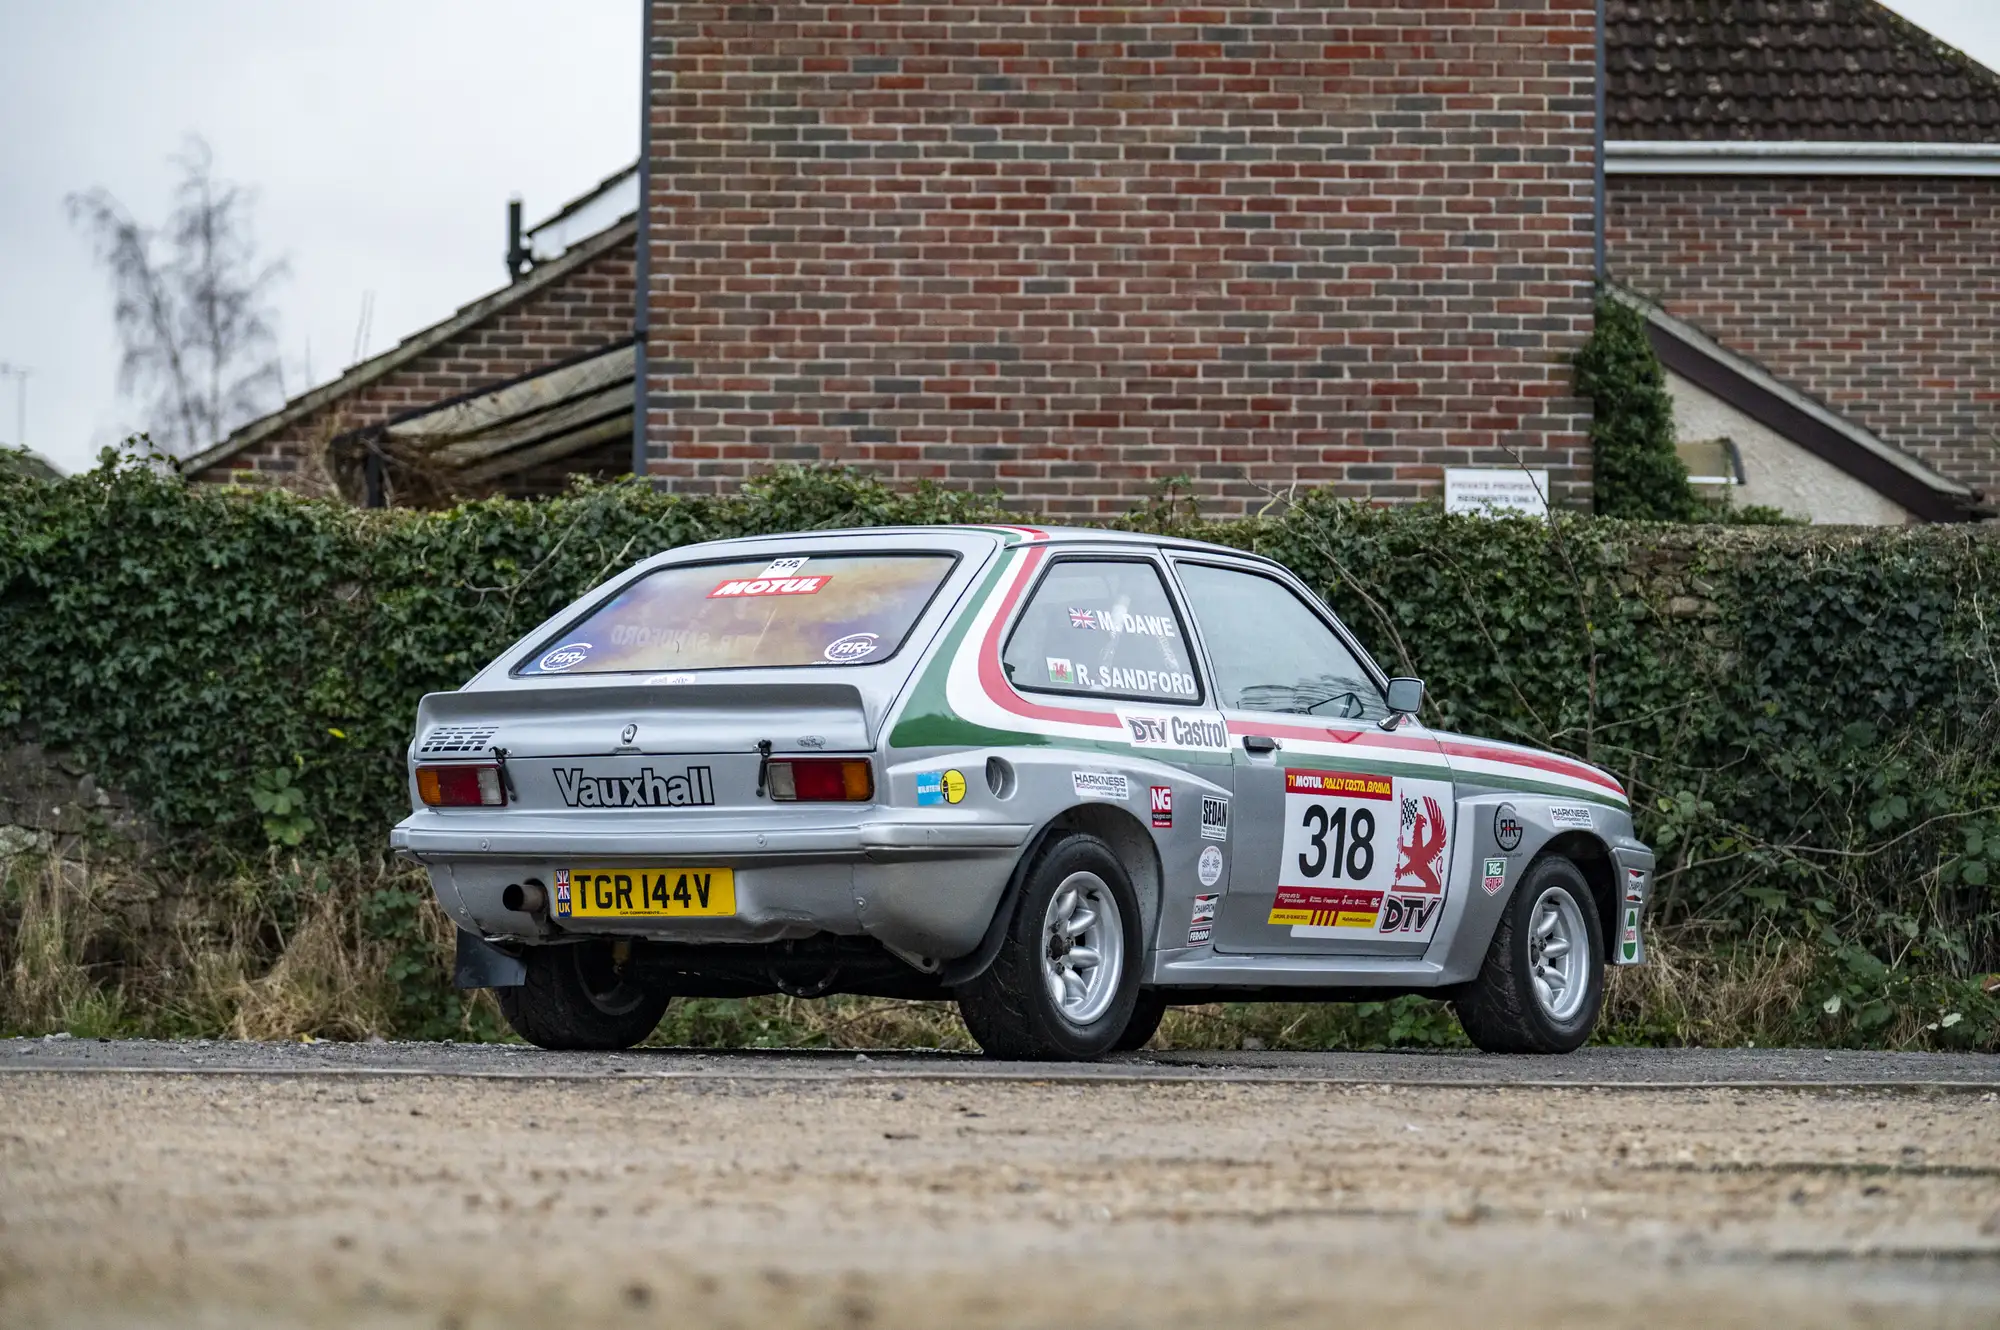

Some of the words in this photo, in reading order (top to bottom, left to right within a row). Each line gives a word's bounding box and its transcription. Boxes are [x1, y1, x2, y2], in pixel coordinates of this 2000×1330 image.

[1450, 481, 1490, 490] PRIVATE
[1513, 494, 1537, 503] ONLY
[712, 578, 821, 596] MOTUL
[1121, 613, 1176, 637] DAWE
[1075, 663, 1096, 686] R.
[1098, 665, 1196, 695] SANDFORD
[1126, 716, 1167, 743] DTV
[1171, 715, 1228, 748] Castrol
[552, 765, 715, 808] Vauxhall
[1074, 773, 1126, 787] HARKNESS
[1296, 775, 1322, 789] MOTUL
[1322, 777, 1344, 791] RALLY
[1344, 779, 1366, 792] COSTA
[1366, 780, 1391, 795] BRAVA
[1151, 788, 1171, 810] NG
[1203, 799, 1228, 828] SEDAN
[1551, 807, 1590, 819] HARKNESS
[1298, 804, 1375, 881] 318
[1488, 862, 1502, 876] TAG
[573, 874, 633, 910] TGR
[641, 873, 711, 909] 144V
[1485, 876, 1503, 892] HEUER
[558, 902, 571, 914] UK
[1379, 895, 1442, 934] DTV
[1190, 930, 1209, 942] FERODO
